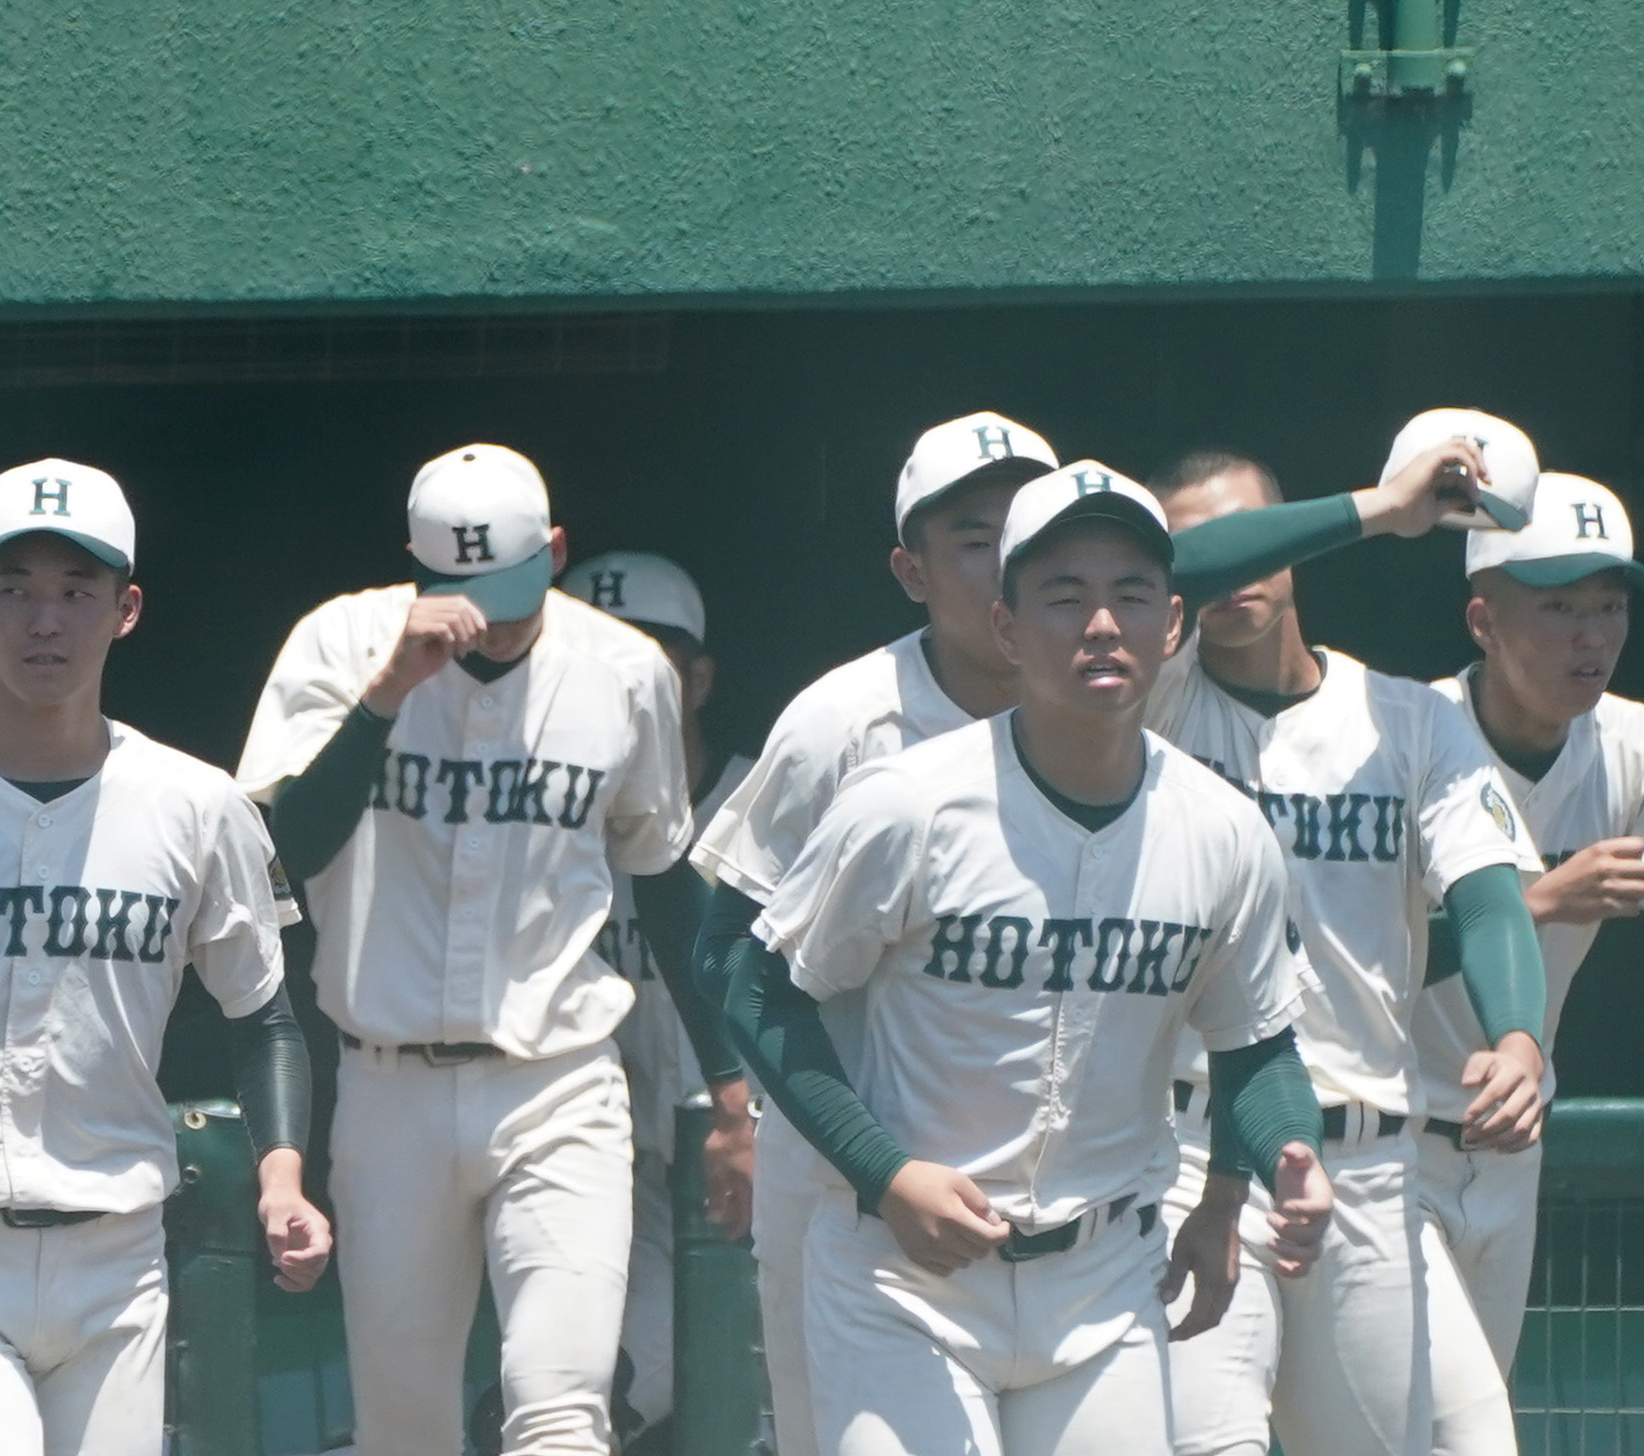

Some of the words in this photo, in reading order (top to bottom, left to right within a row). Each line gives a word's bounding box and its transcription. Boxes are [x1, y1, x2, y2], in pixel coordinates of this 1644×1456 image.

[972, 424, 1015, 460] H
[29, 477, 72, 516] H
[1070, 470, 1113, 498] H
[1570, 502, 1609, 539] H
[452, 523, 496, 564] H
[590, 569, 627, 607] H
[923, 914, 1213, 997] HOTOKU
